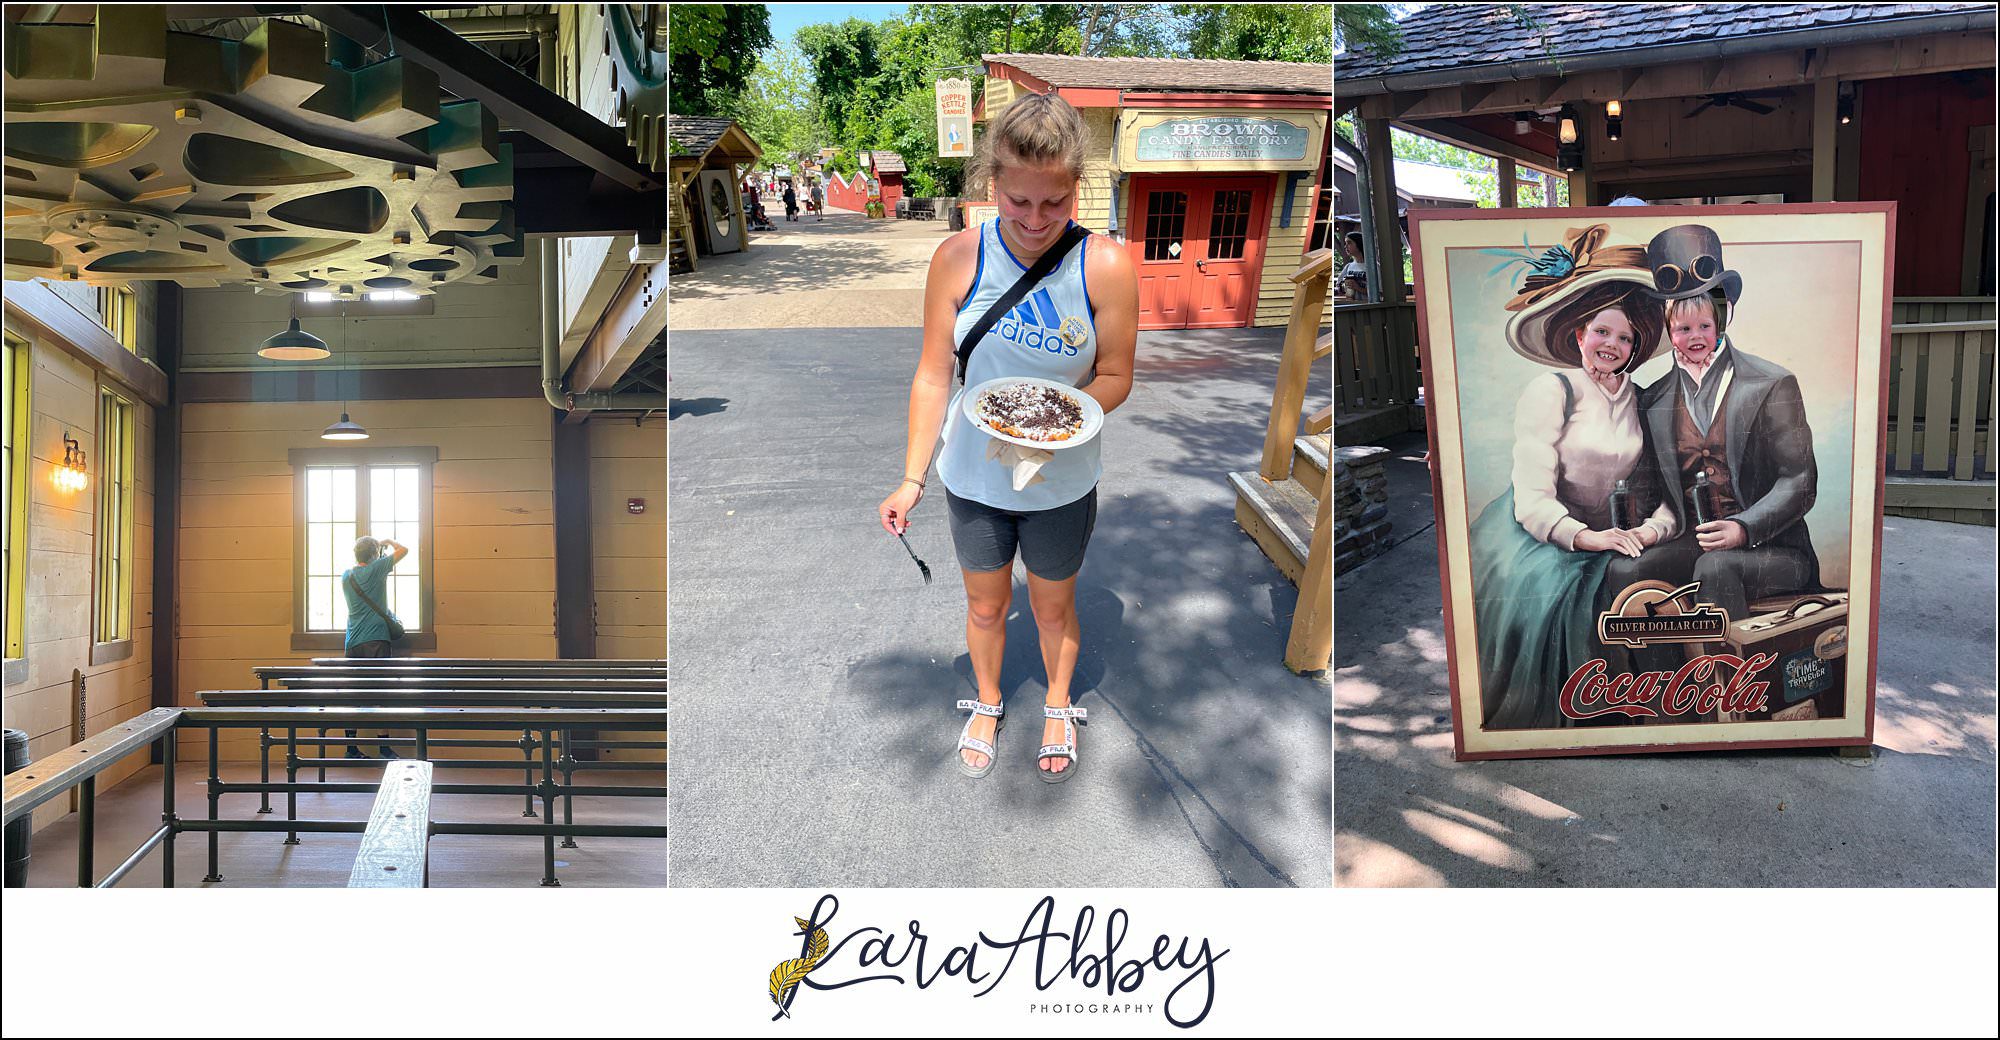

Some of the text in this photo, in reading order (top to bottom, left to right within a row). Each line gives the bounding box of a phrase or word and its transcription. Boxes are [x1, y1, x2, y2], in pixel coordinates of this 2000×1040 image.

[941, 94, 966, 102] COPPER
[941, 101, 967, 109] KETTLE
[1171, 124, 1279, 137] BROWN
[1148, 136, 1291, 147] CANDY FACTORY
[1172, 150, 1263, 158] FINE CANDIES DAILY
[1609, 619, 1718, 633] SILVER DOLLAR CITY
[1795, 660, 1818, 678] TIME
[1788, 667, 1825, 688] TRAVELER
[1559, 652, 1778, 720] Coca-Cola
[979, 704, 993, 713] FILA
